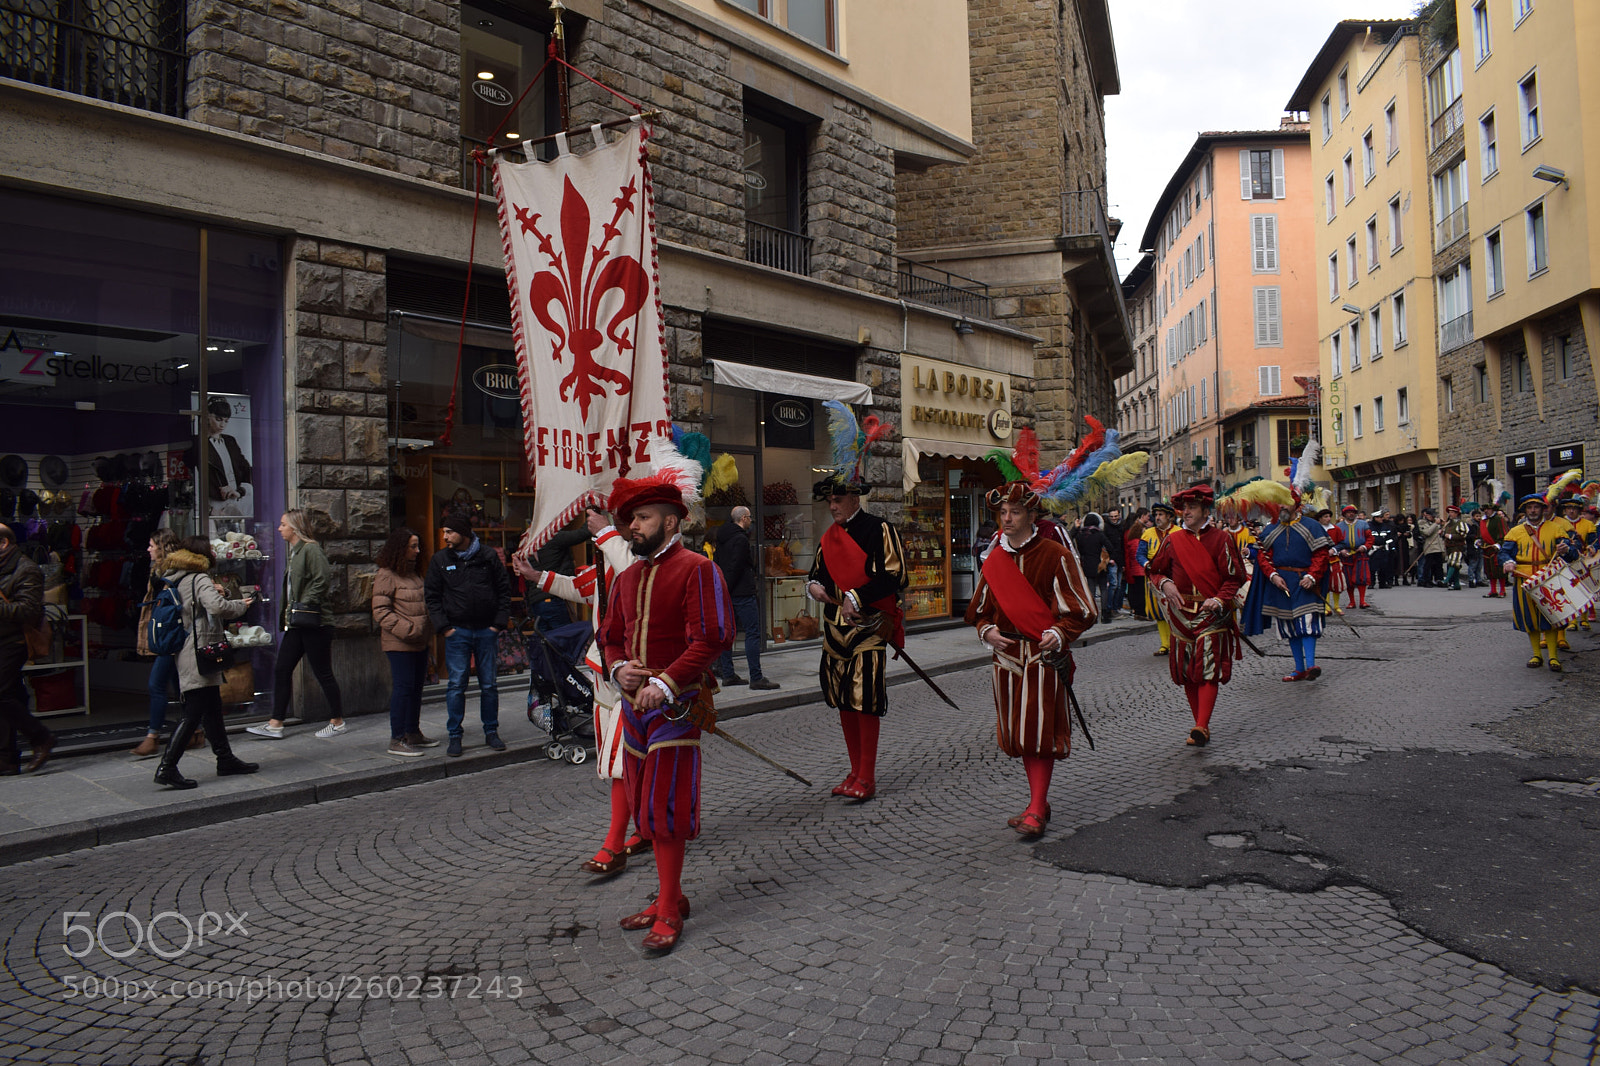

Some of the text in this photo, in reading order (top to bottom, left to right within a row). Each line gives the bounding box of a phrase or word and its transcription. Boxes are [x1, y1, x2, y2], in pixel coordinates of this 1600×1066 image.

[46, 354, 180, 386] stellazeta
[943, 371, 1006, 403] BORSA
[911, 405, 986, 430] RISTORANTE
